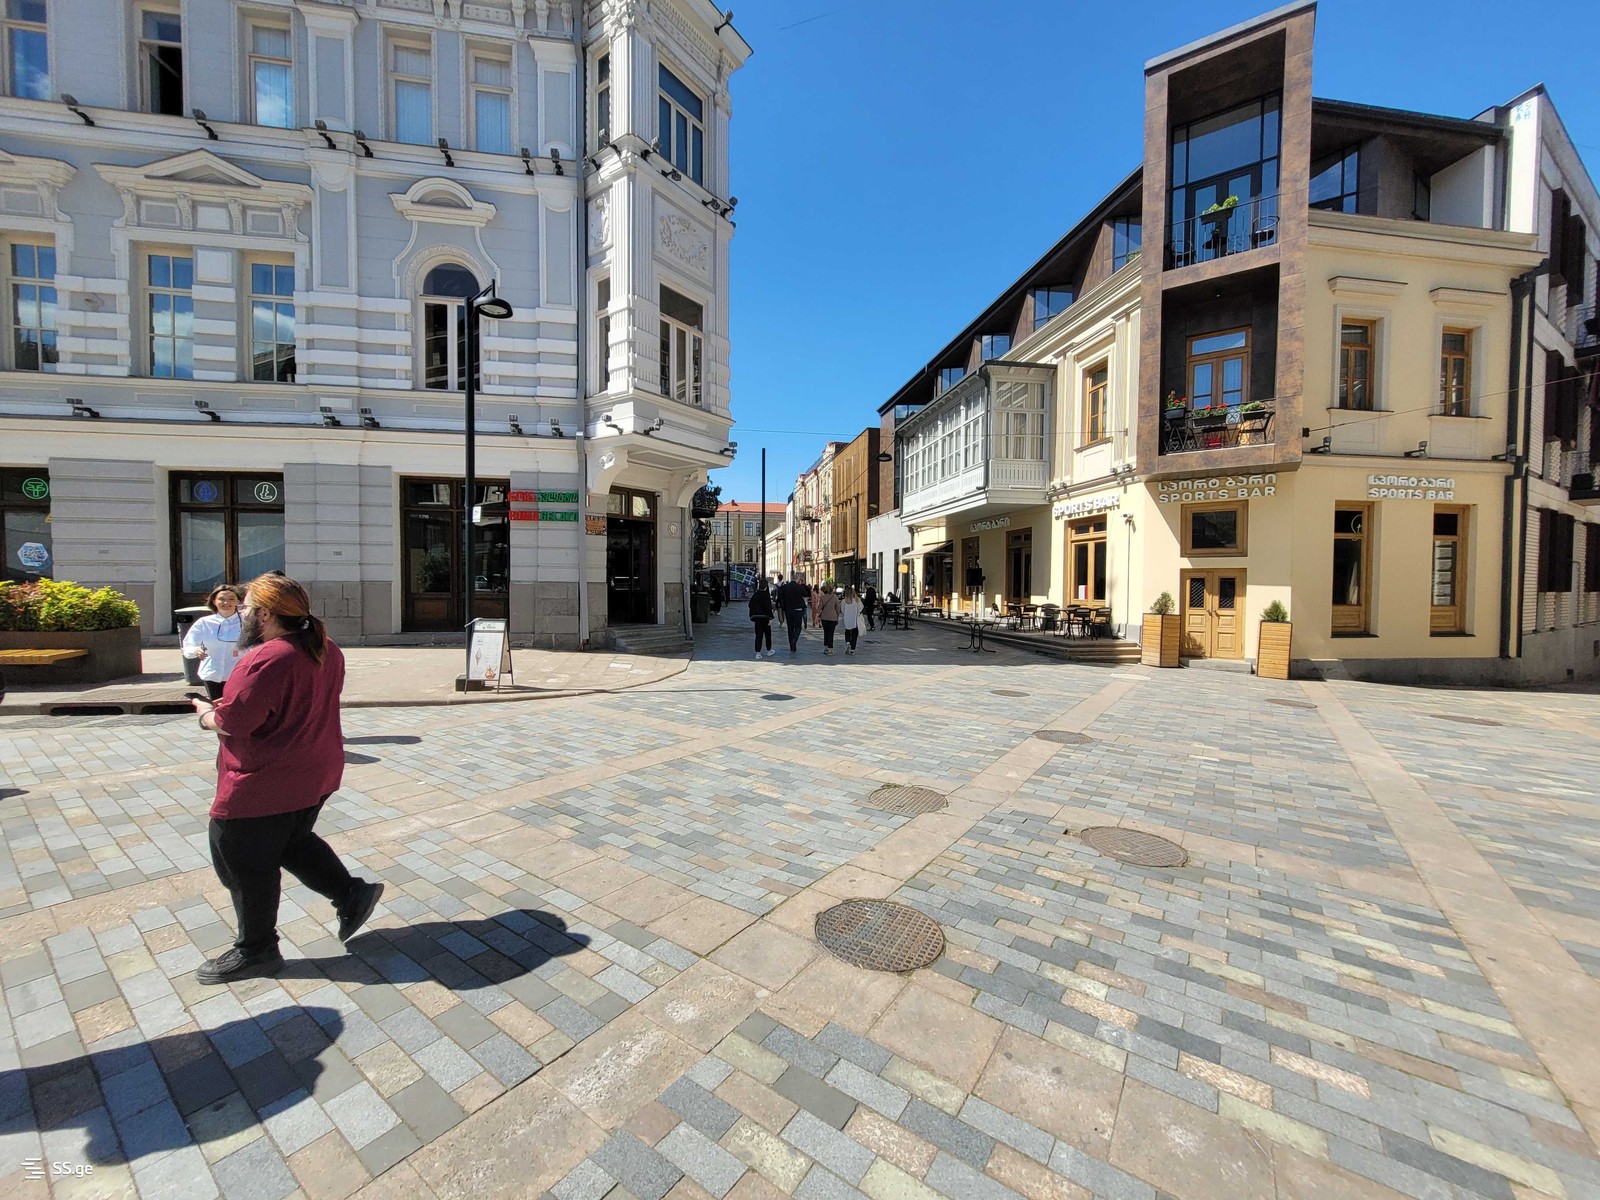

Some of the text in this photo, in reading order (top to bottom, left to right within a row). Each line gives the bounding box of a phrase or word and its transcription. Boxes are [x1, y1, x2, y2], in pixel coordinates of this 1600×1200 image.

[1158, 473, 1277, 492] სპორტ ბარი
[1418, 477, 1455, 488] ბარი
[1159, 486, 1276, 503] SPORTS BAR
[1368, 487, 1454, 500] SPORTS BAR
[1053, 495, 1120, 517] SPORTS BAR
